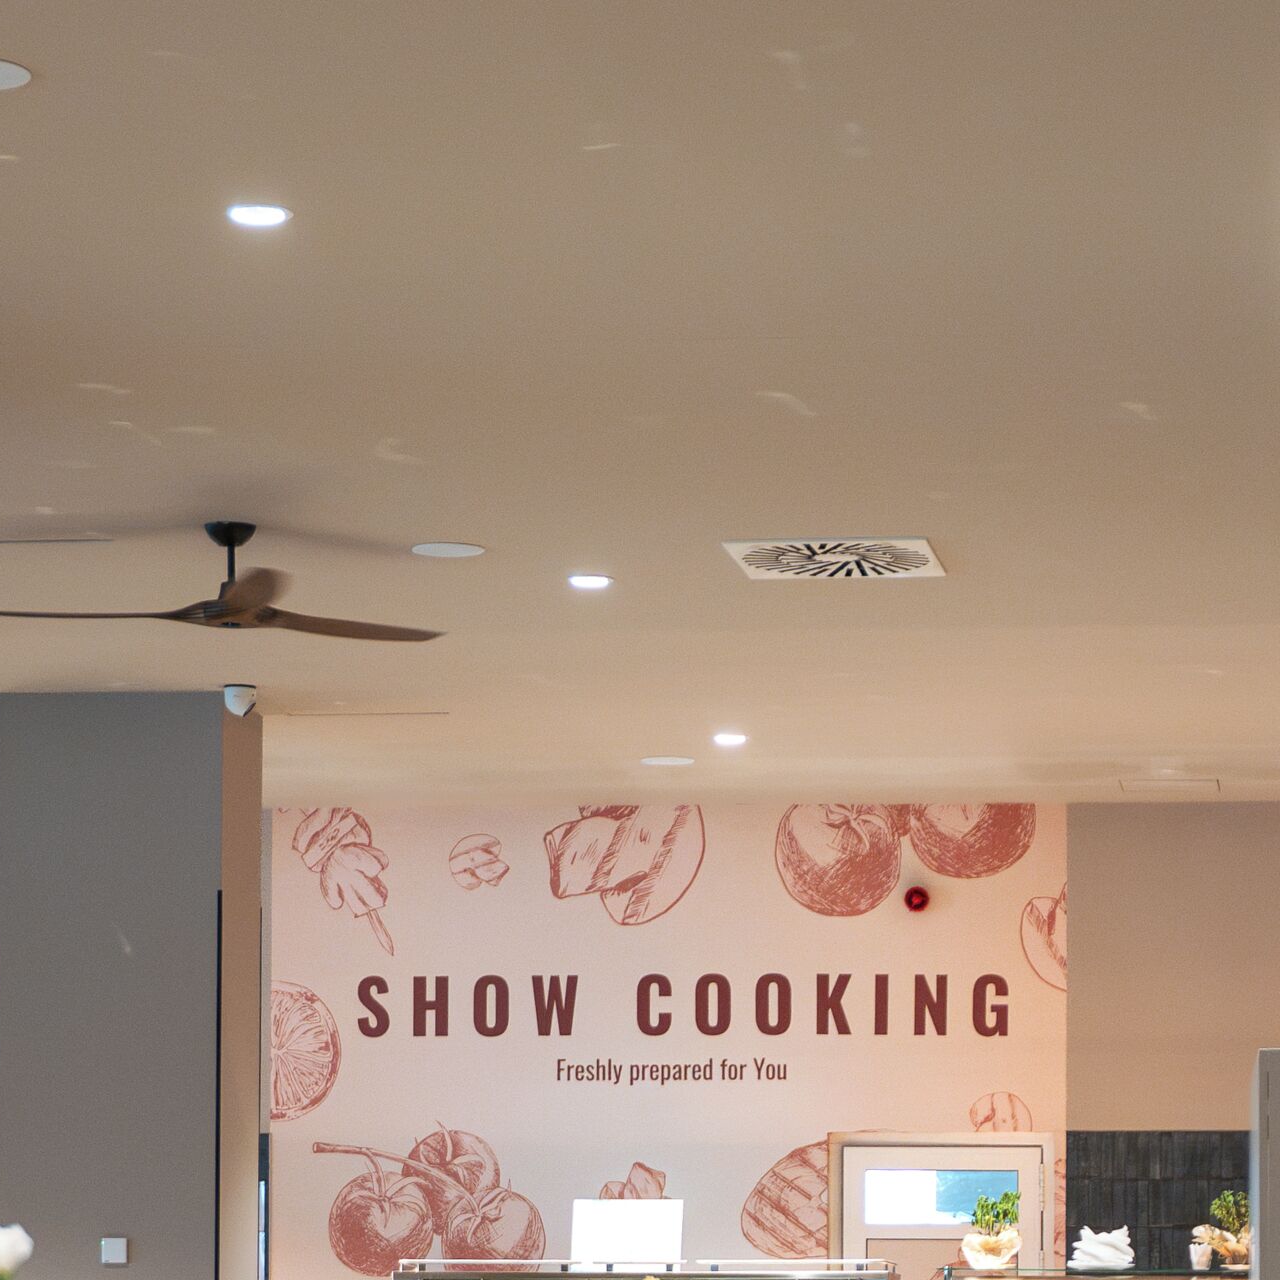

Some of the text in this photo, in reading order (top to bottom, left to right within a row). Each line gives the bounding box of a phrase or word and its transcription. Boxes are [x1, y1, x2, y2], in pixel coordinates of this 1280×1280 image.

[356, 972, 1009, 1038] SHOW COOKING
[555, 1057, 787, 1086] Freshly prepared for You
